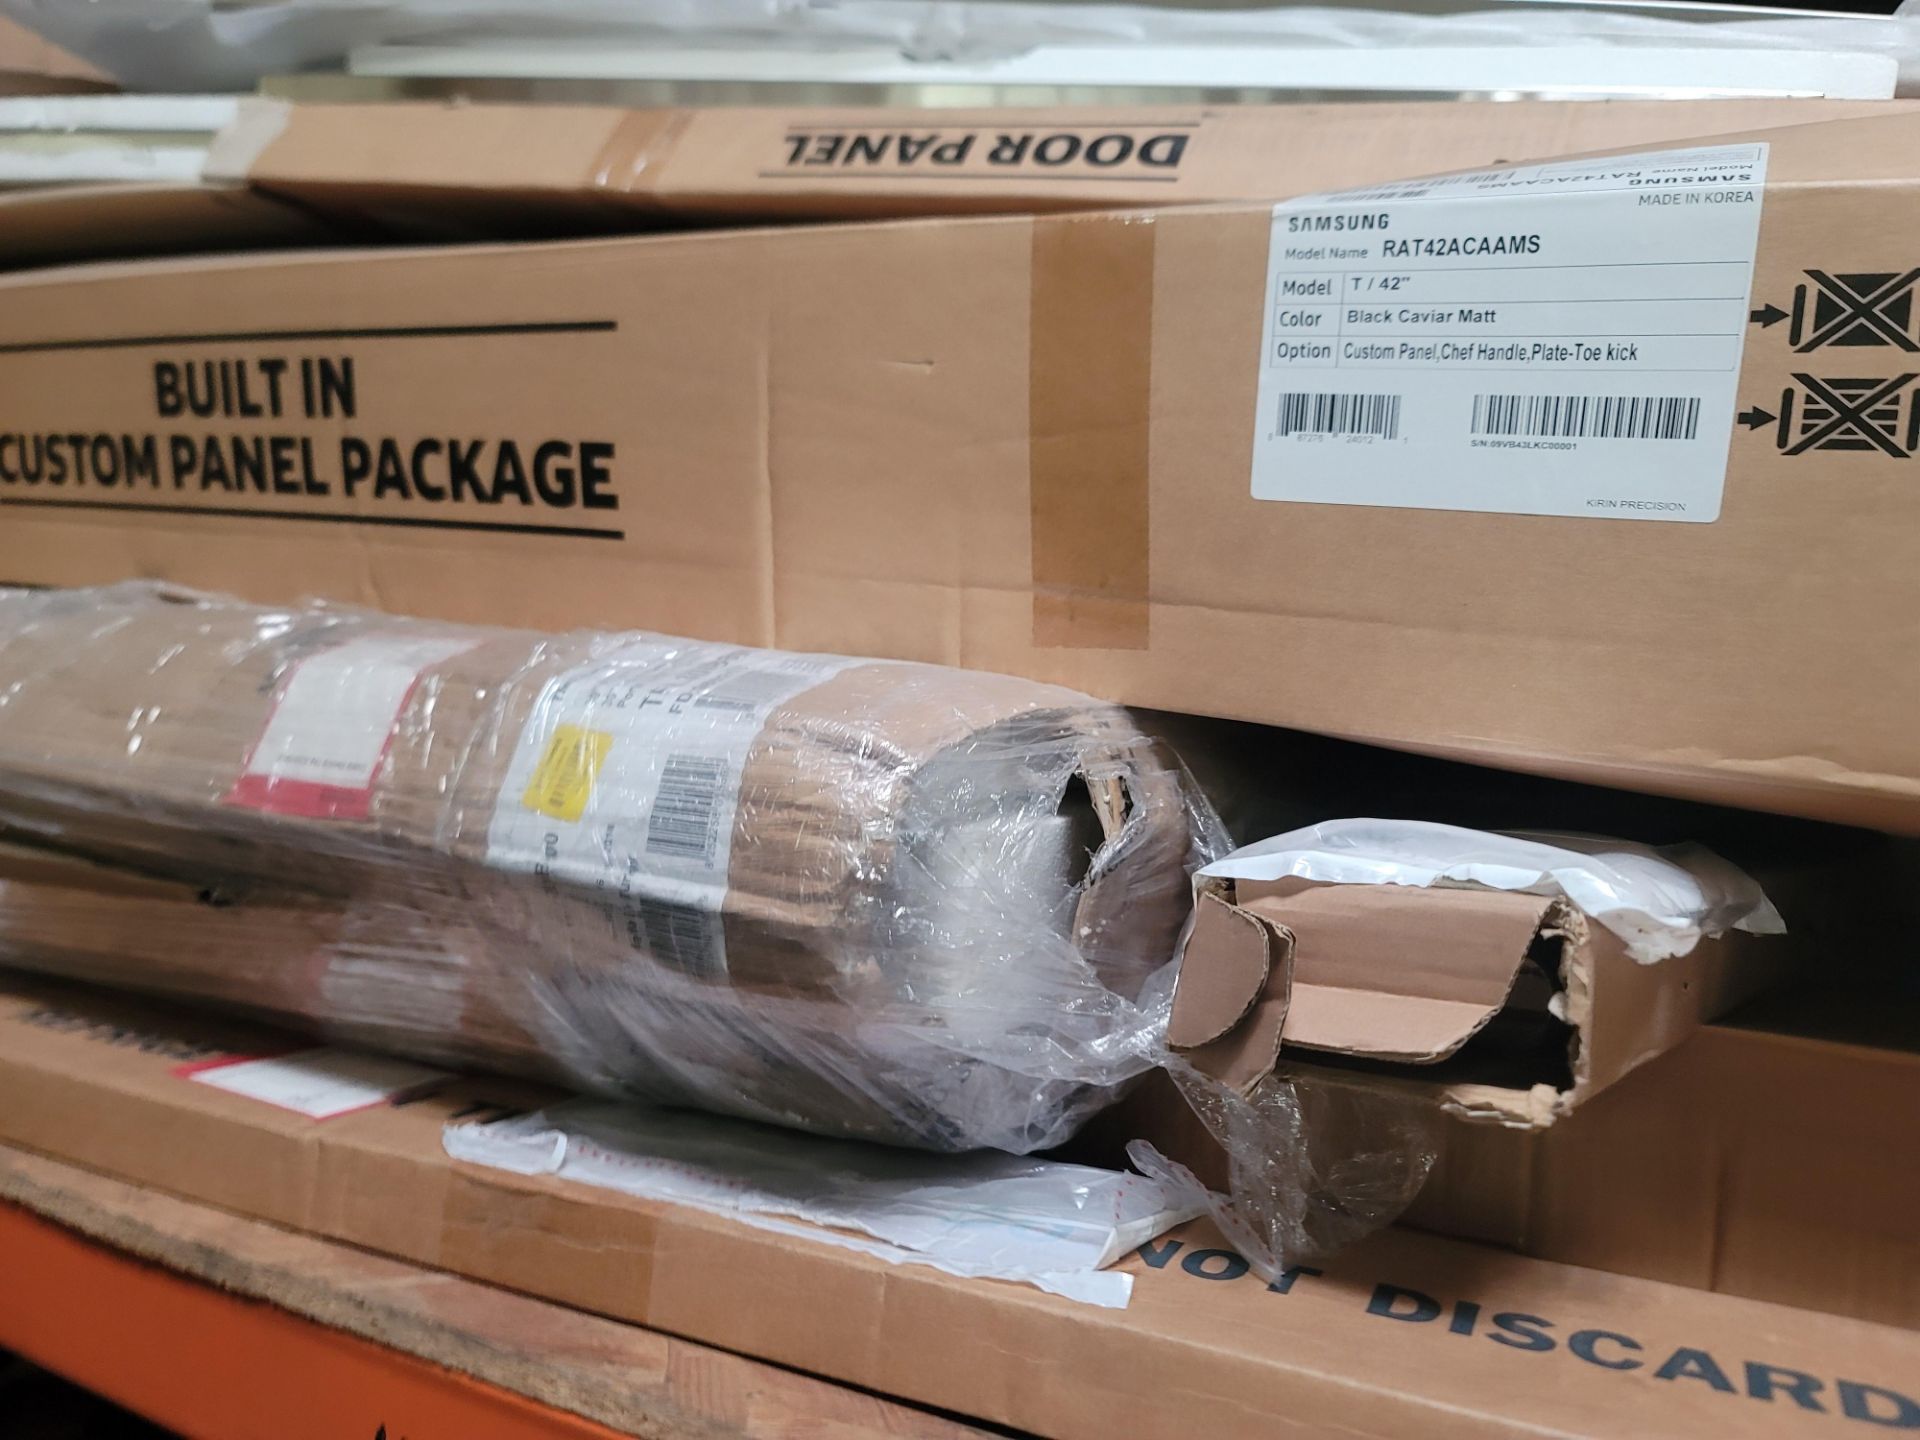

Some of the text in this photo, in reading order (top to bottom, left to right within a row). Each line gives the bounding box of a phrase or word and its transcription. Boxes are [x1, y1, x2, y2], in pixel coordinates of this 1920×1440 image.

[784, 133, 1190, 169] DOOR PANEL
[1627, 173, 1752, 187] SAMSUNG
[1639, 191, 1755, 206] MADE IN KOREA
[1288, 213, 1390, 233] SAMSUNG
[1284, 245, 1368, 260] Model Name
[1382, 235, 1541, 259] RAT42ACAAMS
[1282, 279, 1332, 297] Model
[1351, 277, 1362, 292] T
[1279, 310, 1322, 328] Color
[1346, 308, 1497, 324] Black Caviar Matt
[1277, 342, 1332, 363] Option
[1343, 343, 1395, 361] Custom
[1606, 343, 1639, 361] kick
[153, 356, 357, 419] BUILT IN
[0, 433, 620, 511] CUSTOM PANEL PACKAGE
[1586, 498, 1687, 512] KIRIN PRECISION
[1365, 1283, 1920, 1431] DISCARD
